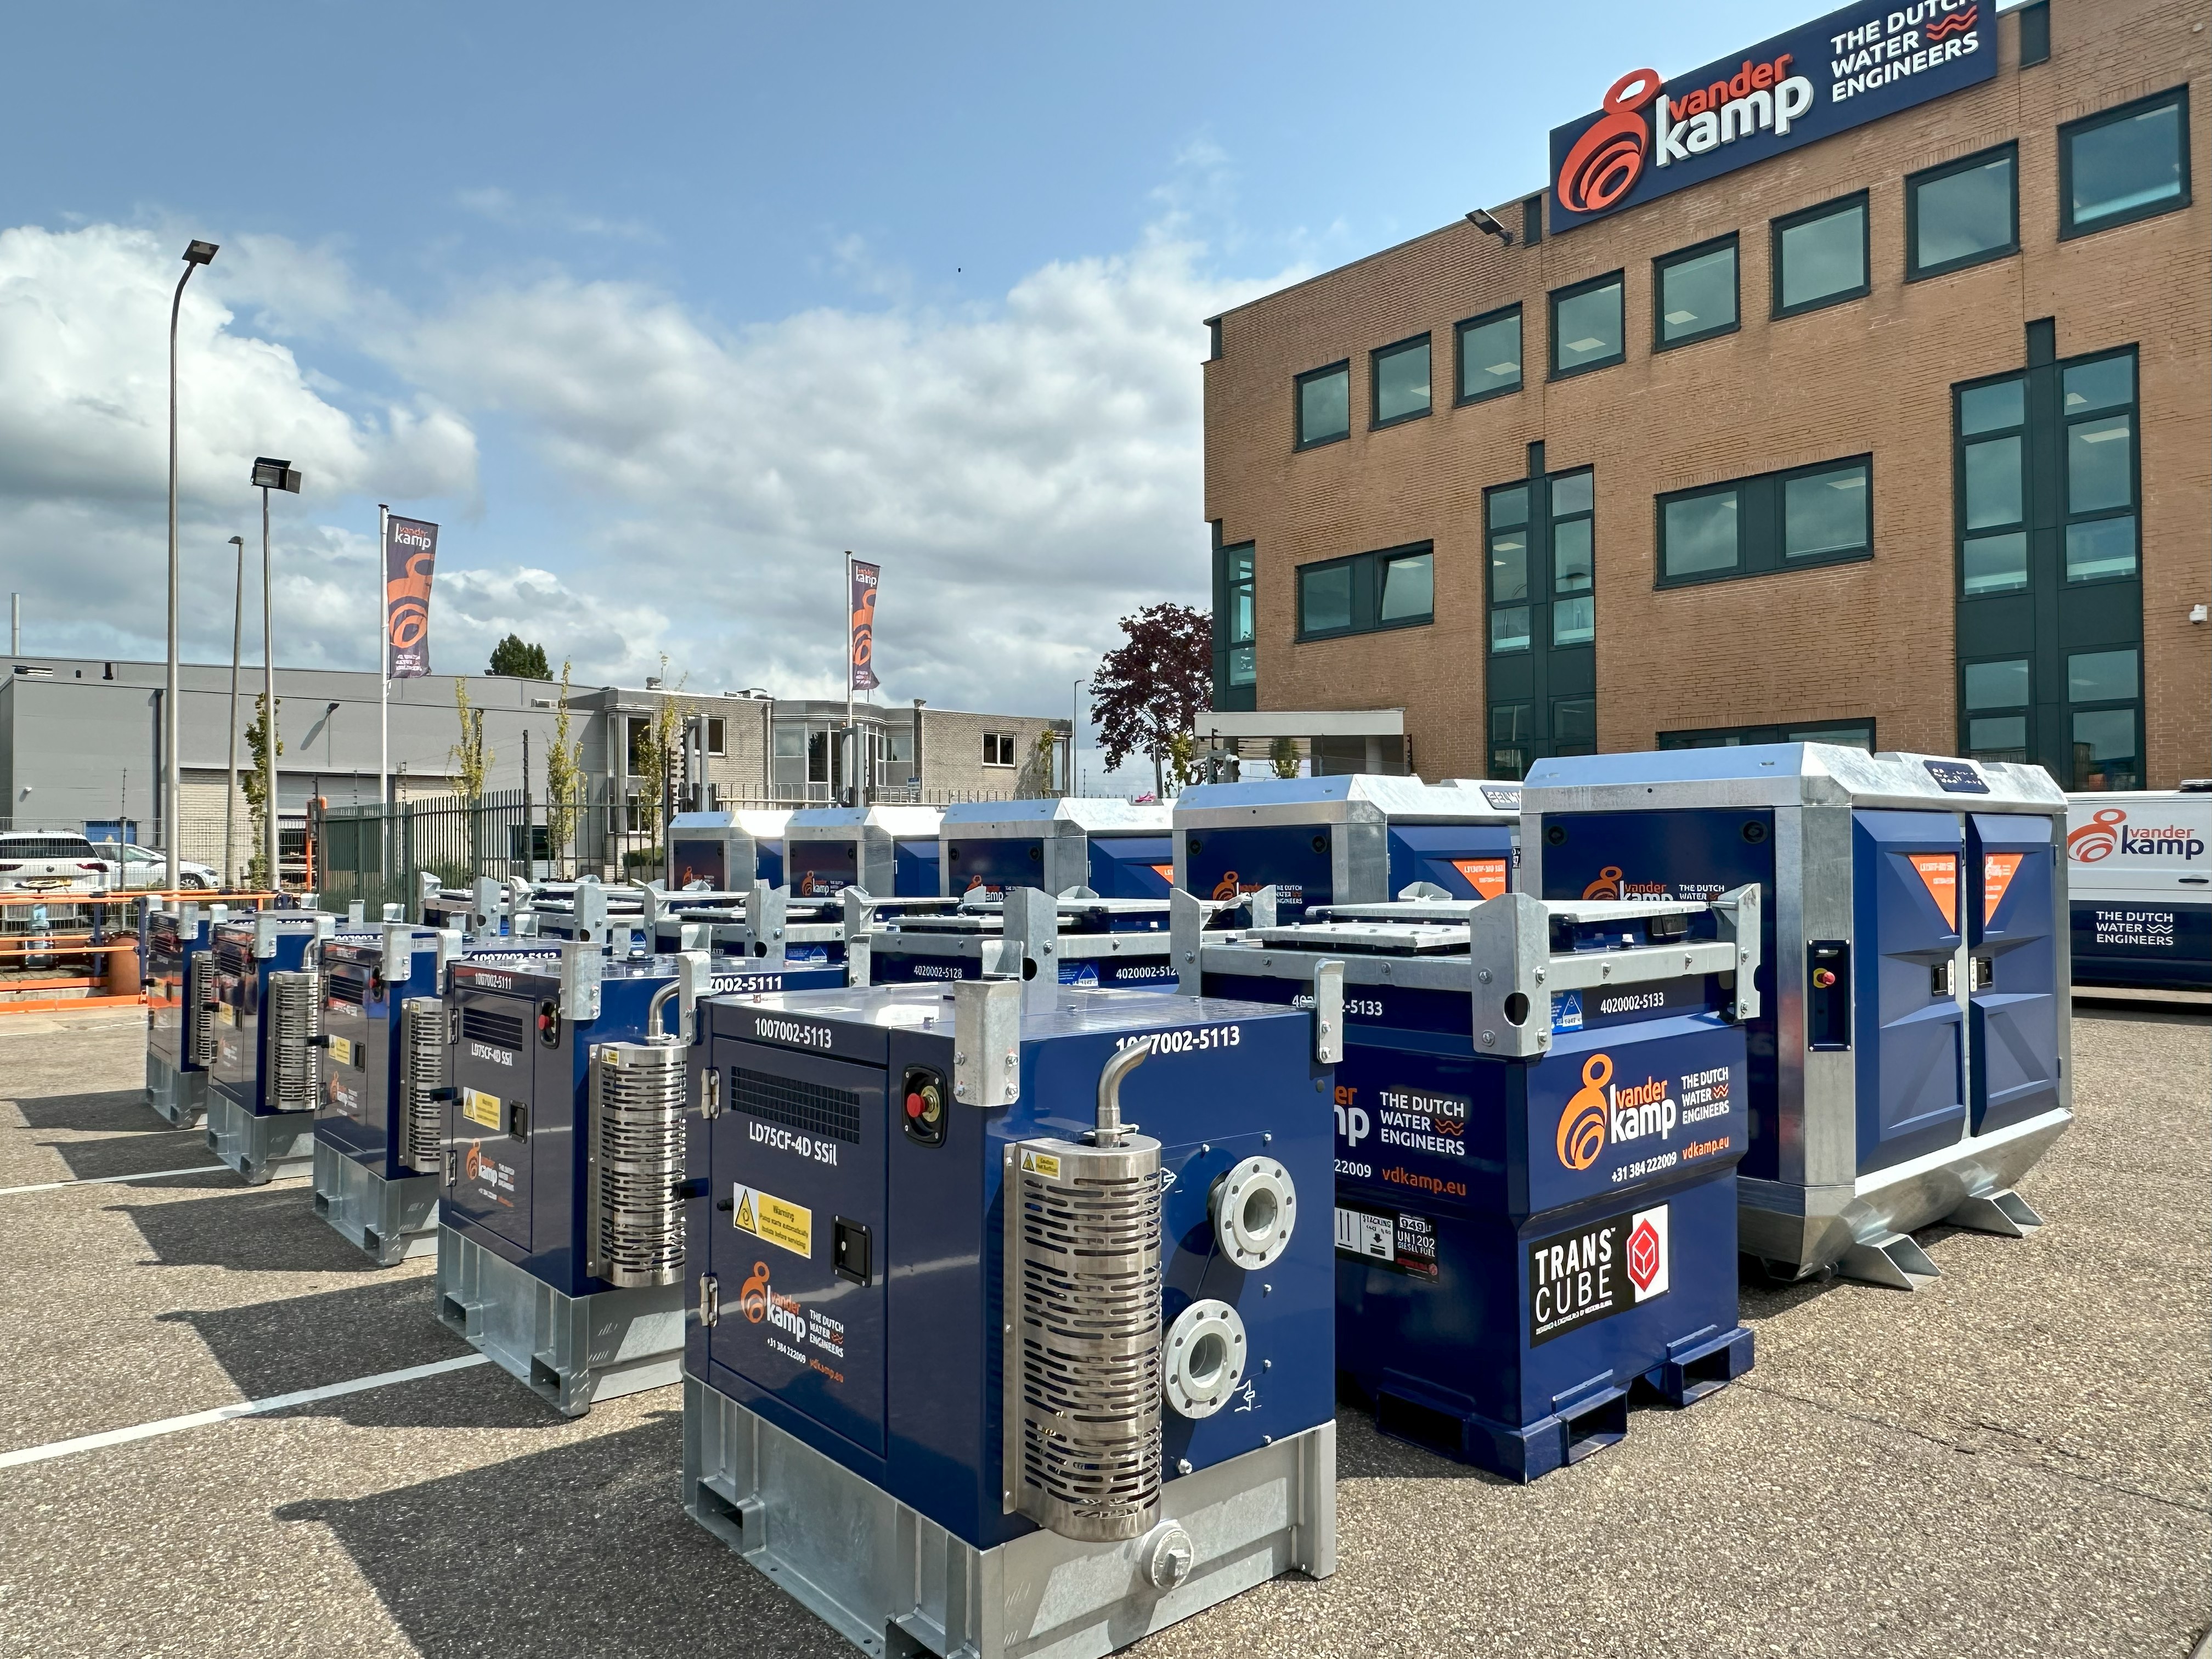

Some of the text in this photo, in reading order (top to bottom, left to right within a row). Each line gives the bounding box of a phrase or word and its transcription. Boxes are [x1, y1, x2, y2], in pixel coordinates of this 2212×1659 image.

[1831, 20, 1881, 55] THE
[1831, 30, 1919, 78] WATER
[1832, 31, 1979, 103] ENGINEERS
[1668, 53, 1793, 121] vander
[1656, 75, 1814, 167] kamp
[395, 523, 431, 551] kamp
[2121, 825, 2204, 860] kamp
[2130, 825, 2194, 838] vander
[2096, 911, 2174, 923] THE DUTCH
[2096, 922, 2142, 933] WATER
[2096, 934, 2174, 946] ENGINEERS
[1116, 966, 1179, 979] 4020002-512
[1600, 992, 1664, 1013] 4020002-5133
[755, 1018, 832, 1048] 1007002-5113
[1681, 1066, 1729, 1090] THE DUTCH
[1379, 1091, 1464, 1118] THE DUTCH
[1616, 1076, 1668, 1109] vander
[1681, 1089, 1712, 1107] WATER
[1380, 1109, 1431, 1131] WATER
[1610, 1084, 1677, 1144] kamp
[1682, 1100, 1730, 1125] ENGINEERS
[749, 1121, 837, 1166] LD75CF-4D SSil
[1381, 1128, 1465, 1156] ENGINEERS
[1611, 1136, 1730, 1183] +31 384 222009 vdkamp.eu
[1382, 1166, 1466, 1197] vdkamp.eu
[1400, 1218, 1425, 1232] 949
[1397, 1230, 1435, 1249] UN1202
[1535, 1228, 1612, 1285] TRANS
[1536, 1263, 1613, 1323] CUBE
[766, 1284, 806, 1343] kamp
[823, 1315, 844, 1334] DUTCH
[809, 1321, 831, 1339] WATER
